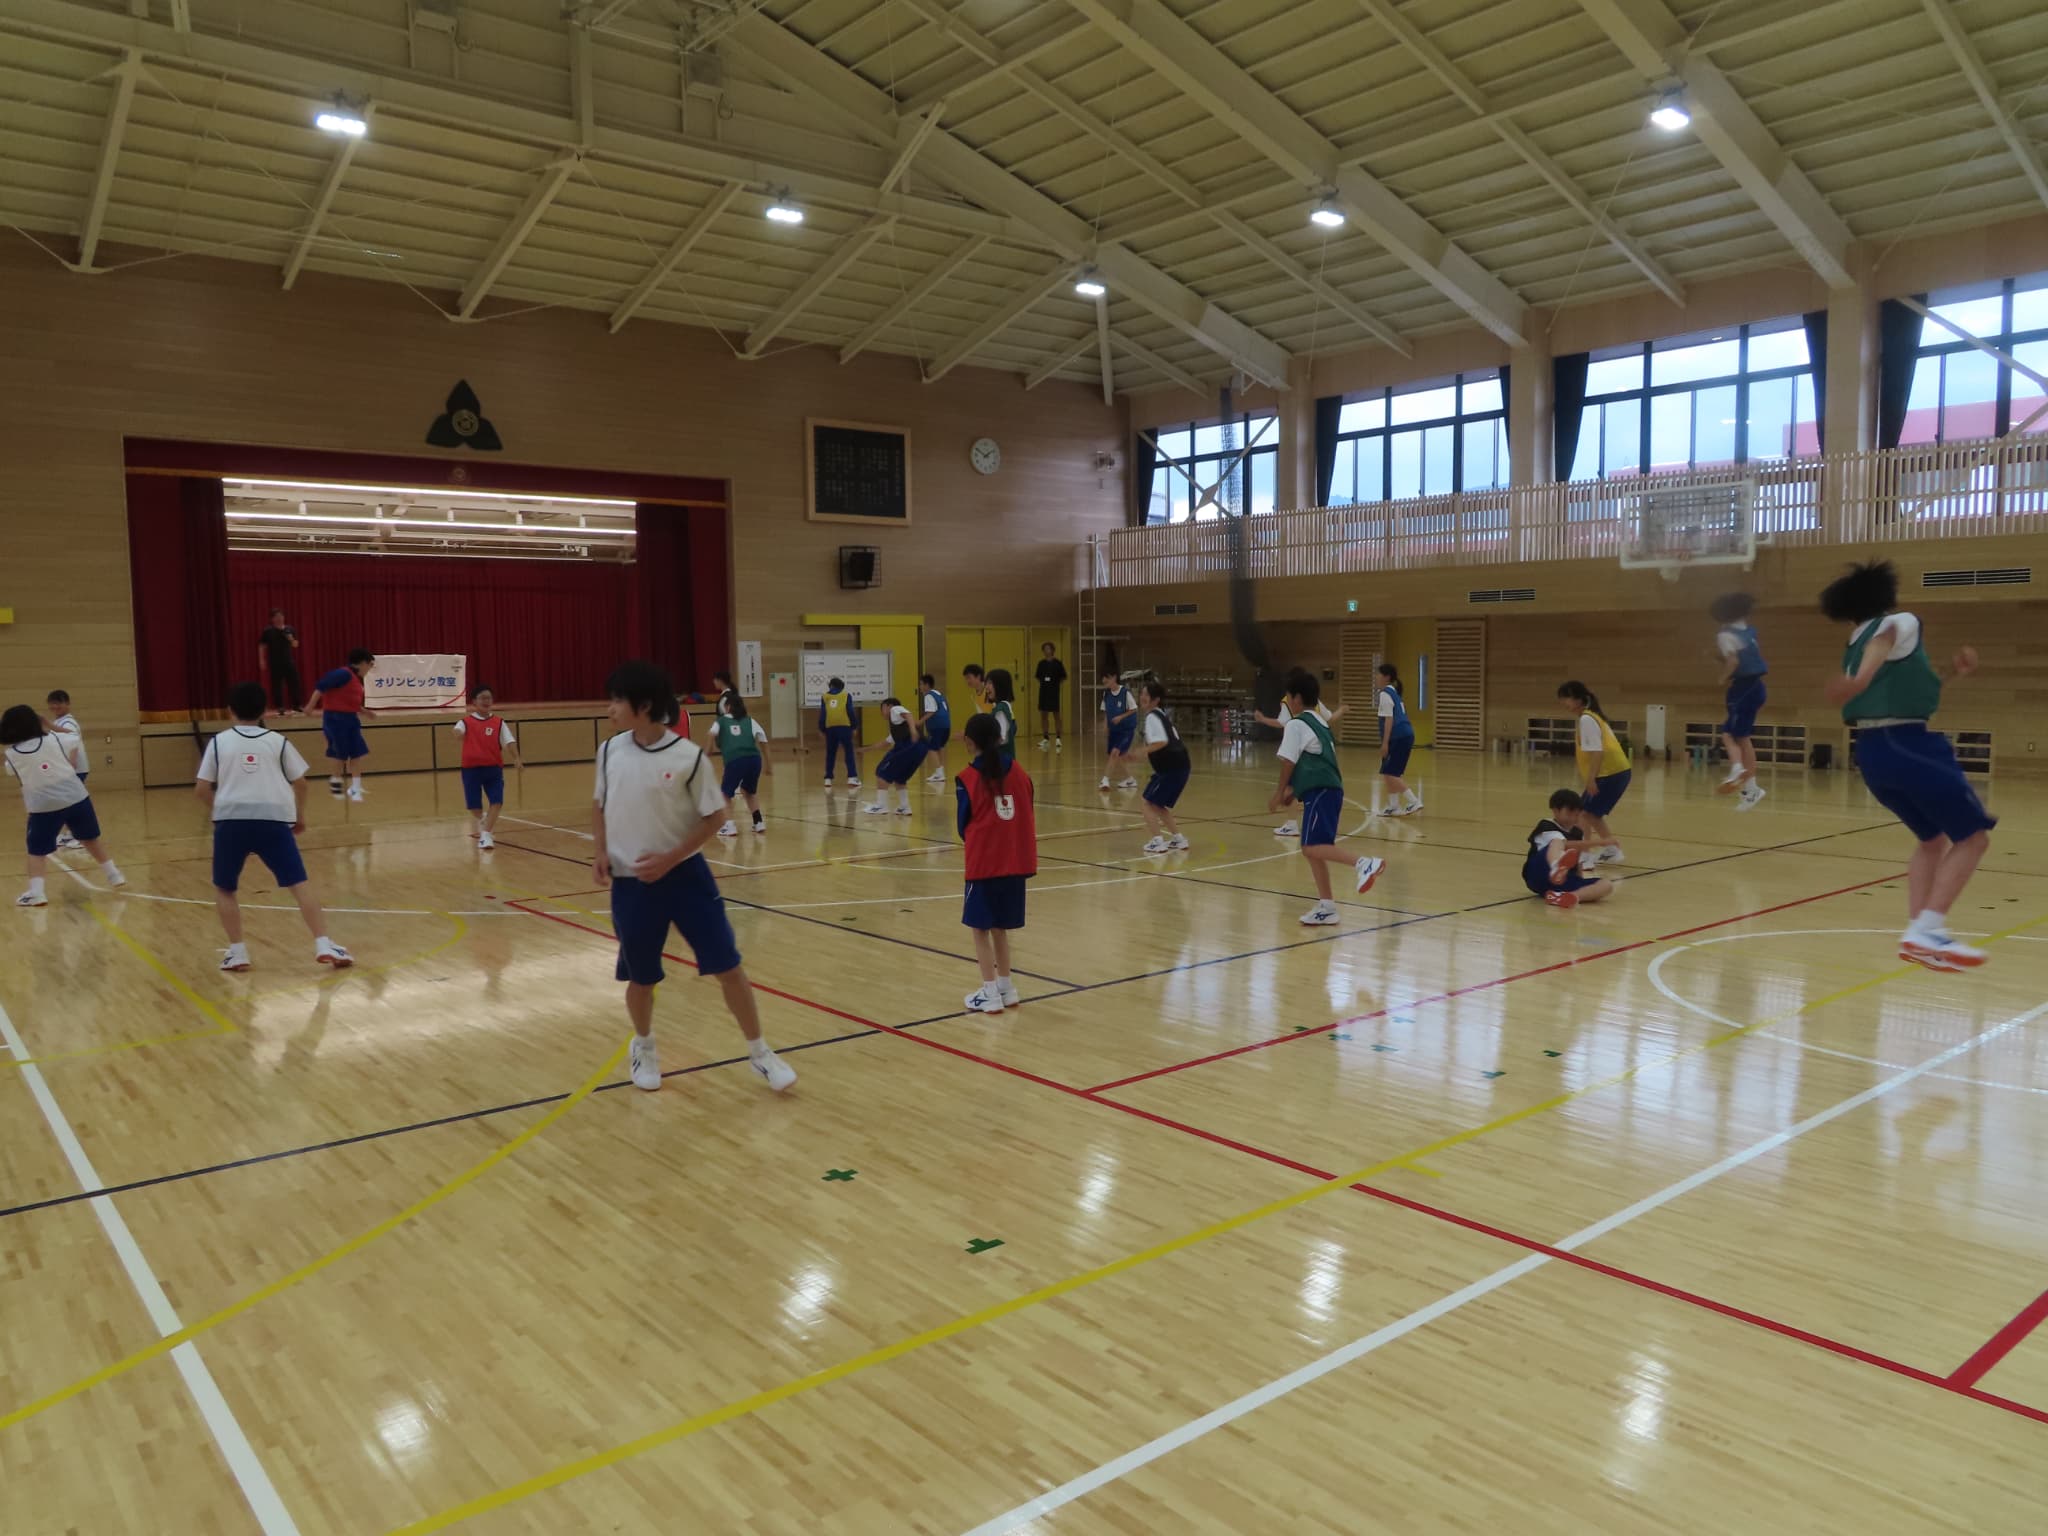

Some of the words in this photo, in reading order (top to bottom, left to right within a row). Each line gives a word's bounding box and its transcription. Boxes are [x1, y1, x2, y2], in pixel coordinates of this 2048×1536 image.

[375, 676, 456, 687] オリンピック教室
